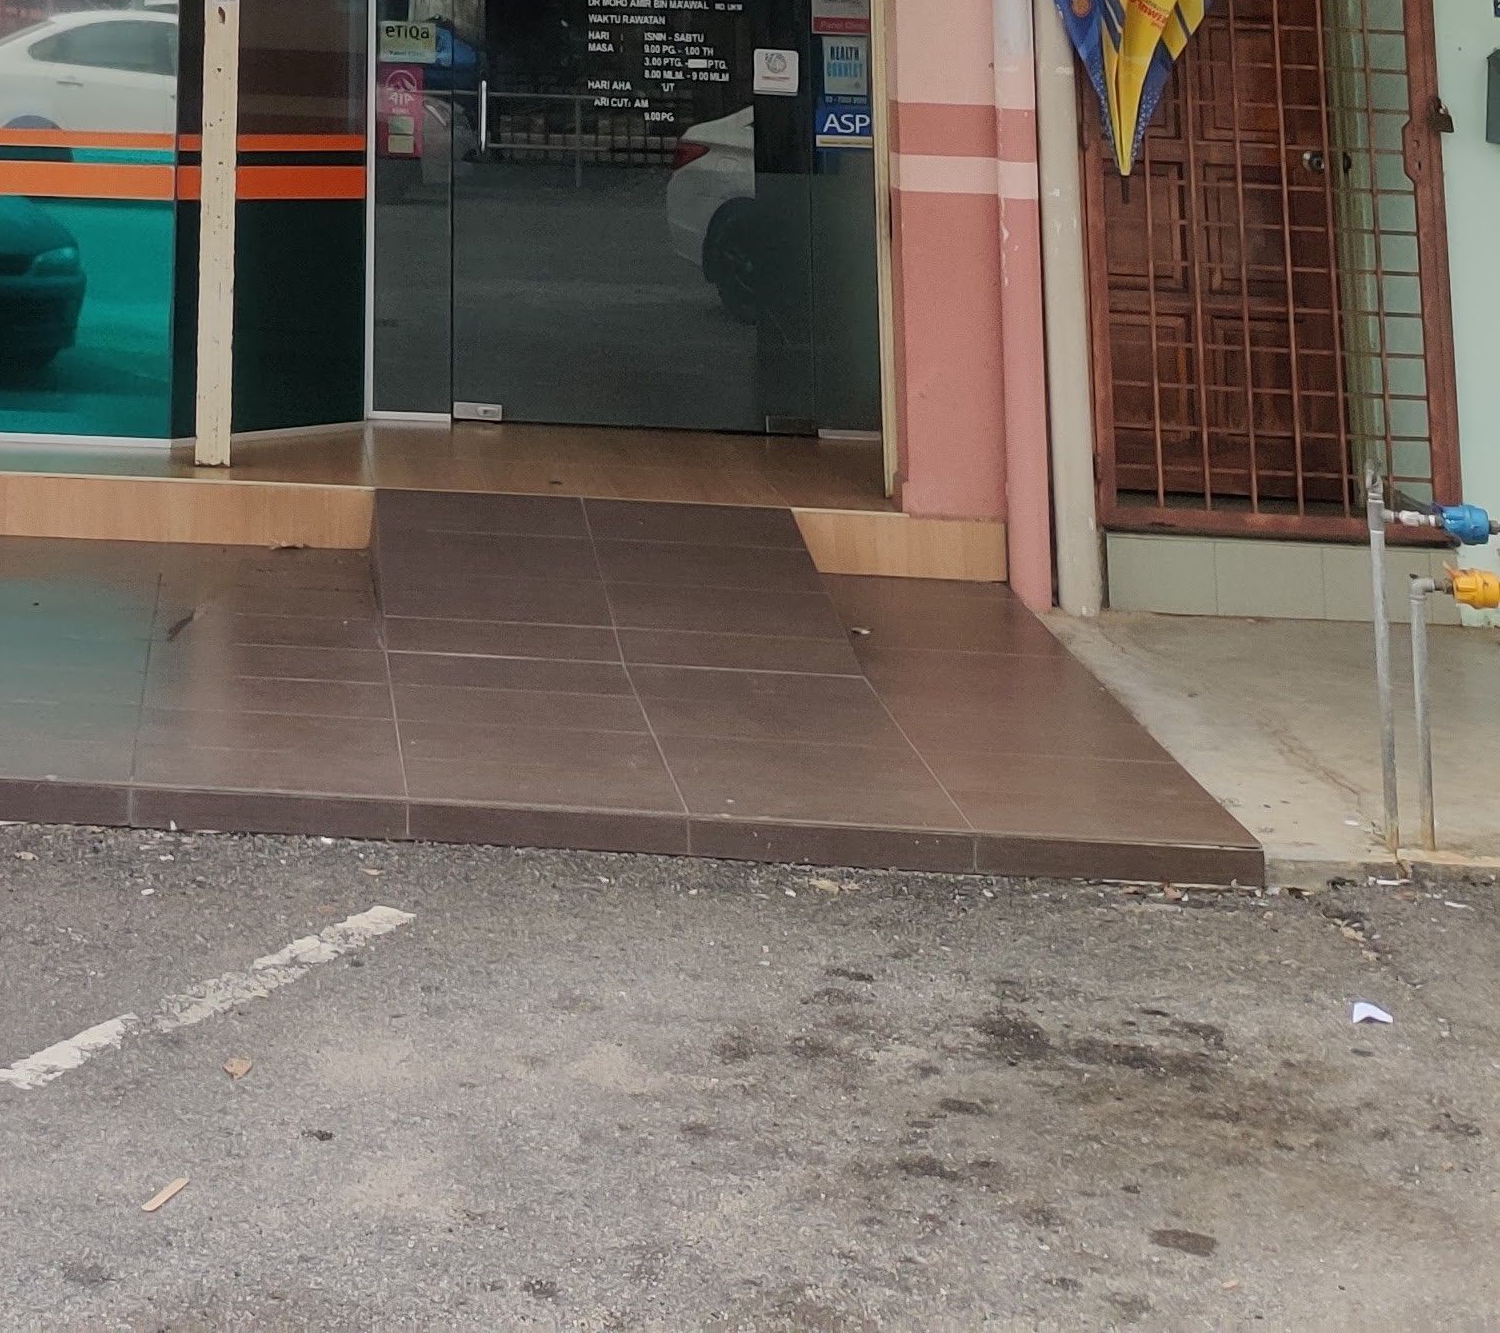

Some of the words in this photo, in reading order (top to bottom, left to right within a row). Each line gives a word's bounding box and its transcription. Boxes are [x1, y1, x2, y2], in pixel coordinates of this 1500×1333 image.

[588, 14, 621, 24] WAKTU
[622, 14, 666, 25] RAWATAN
[588, 31, 610, 40] HARI
[674, 33, 704, 43] SABTU
[588, 42, 614, 52] MASA
[644, 56, 662, 66] 3.00
[588, 80, 610, 90] HARI
[823, 114, 871, 134] ASP
